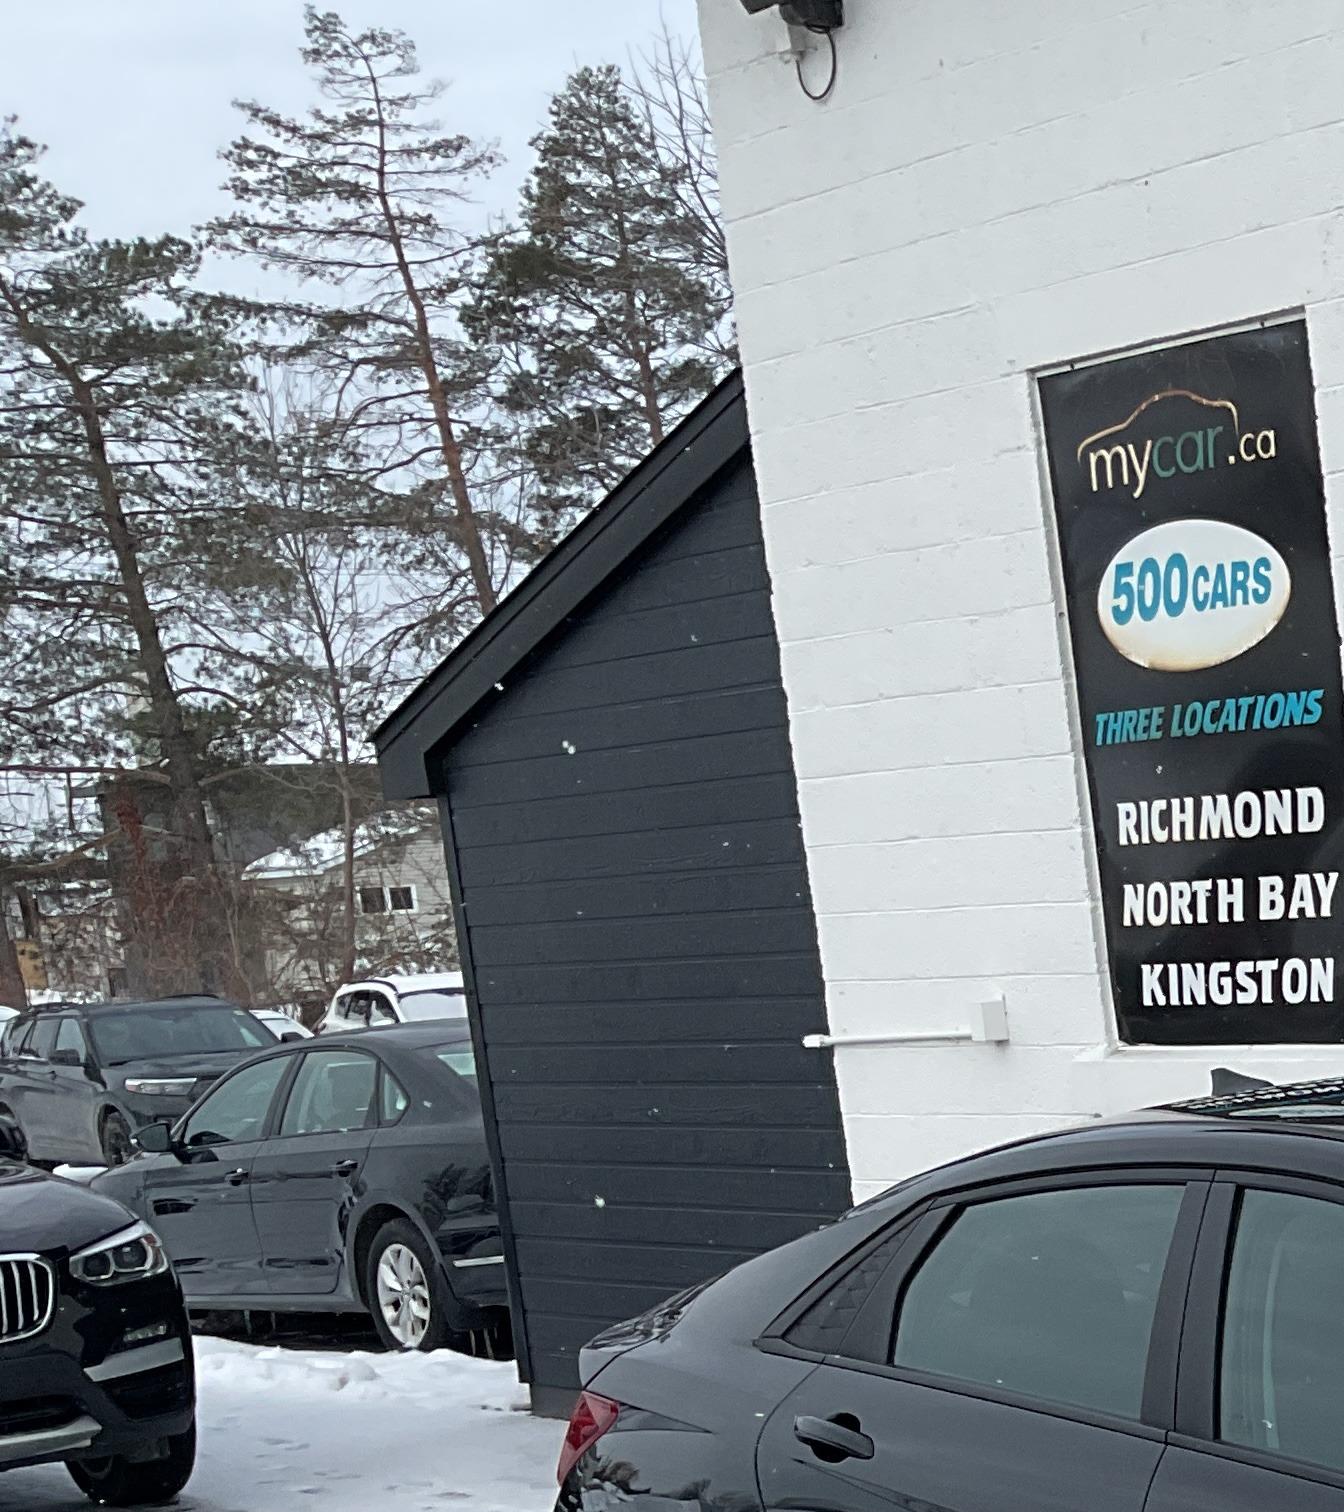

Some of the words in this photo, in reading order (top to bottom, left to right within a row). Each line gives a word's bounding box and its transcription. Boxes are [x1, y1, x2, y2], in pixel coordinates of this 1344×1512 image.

[1088, 426, 1277, 499] mycar.ca
[1095, 706, 1165, 746] THREE
[1170, 689, 1325, 738] LOCATIONS
[1116, 786, 1325, 846] RICHMOND
[1122, 877, 1245, 927] NORTH
[1257, 871, 1340, 921] BAY
[1140, 957, 1335, 1007] KINGSTON
